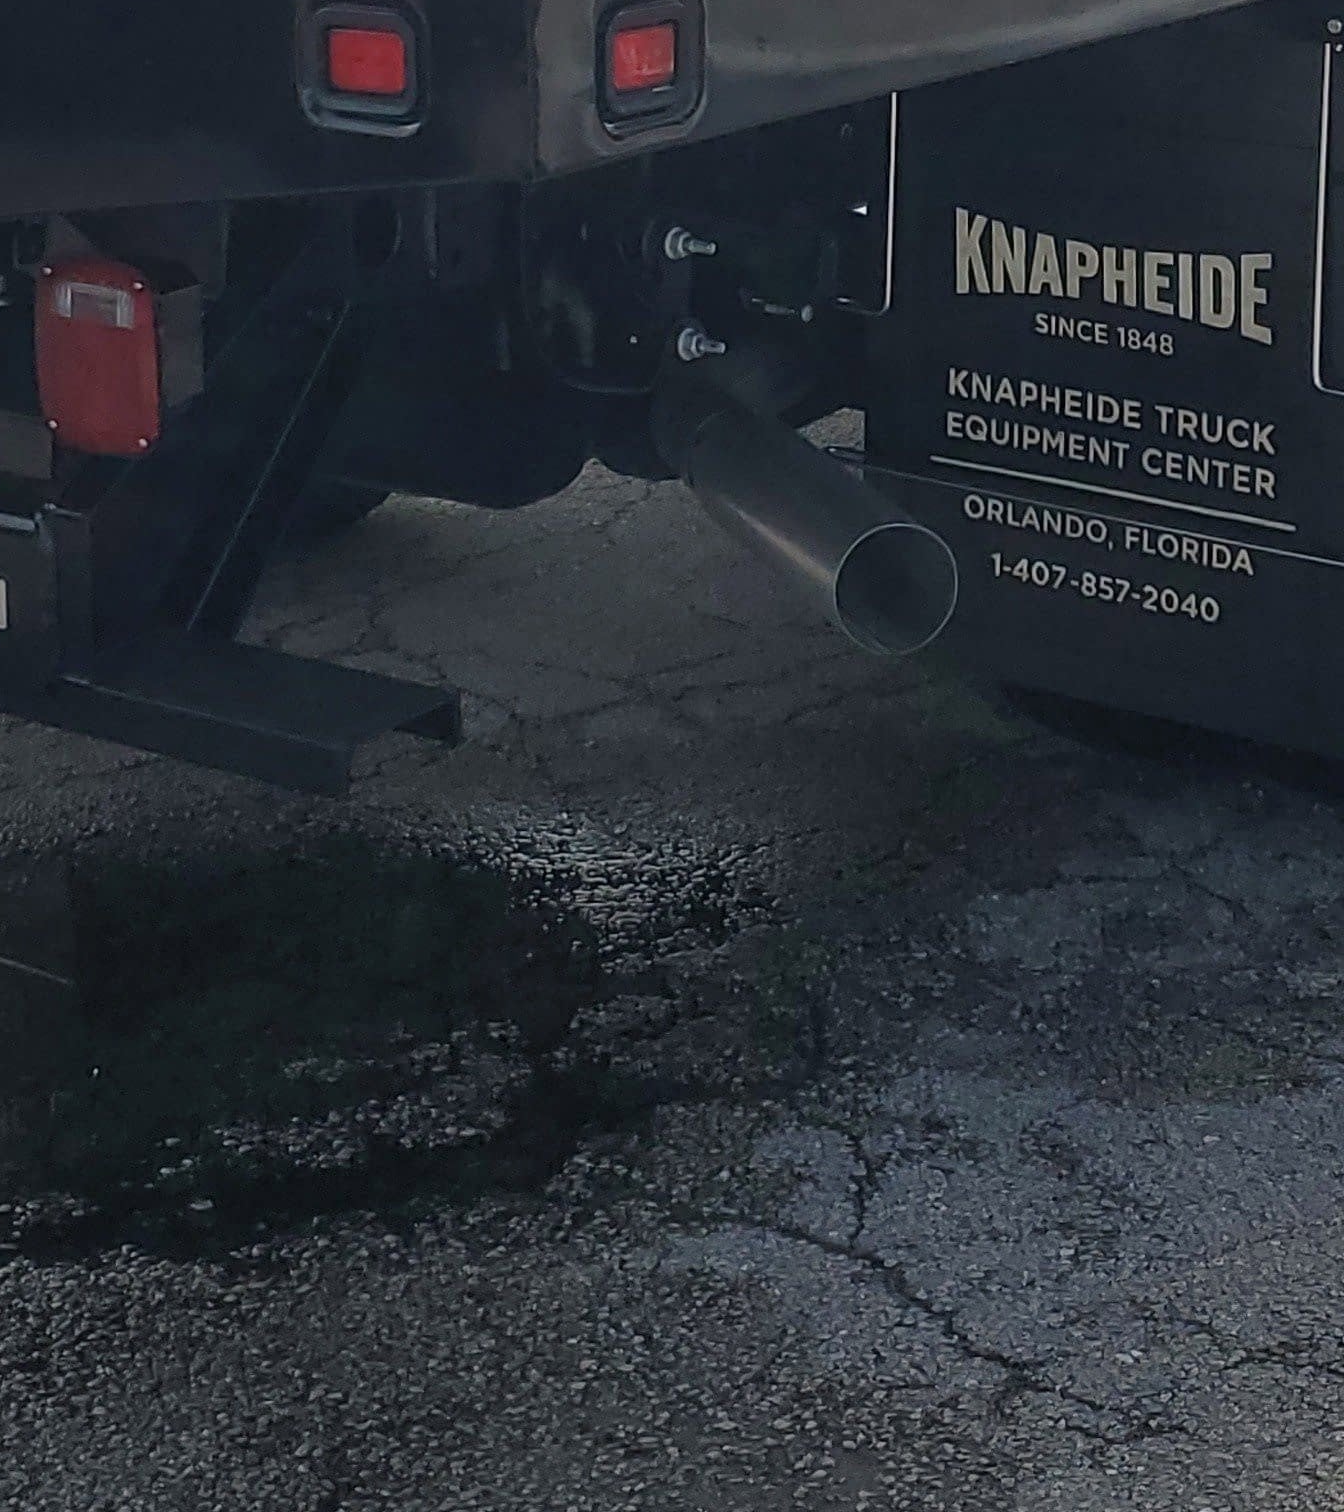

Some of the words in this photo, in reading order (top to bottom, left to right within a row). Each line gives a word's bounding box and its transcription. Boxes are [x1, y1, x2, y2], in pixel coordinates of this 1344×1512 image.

[955, 207, 1272, 345] KNAPHEIDE
[1035, 312, 1109, 345] SINCE
[1116, 325, 1175, 356] 1848
[949, 368, 1142, 429] KNAPHEIDE
[1154, 404, 1276, 455] TRUCK
[946, 411, 1130, 469] EQUIPMENT
[1141, 448, 1276, 499] CENTER
[963, 493, 1115, 551] ORLANDO,
[1124, 527, 1255, 576] FLORIDA
[990, 552, 1221, 622] 1-407-857-2040
